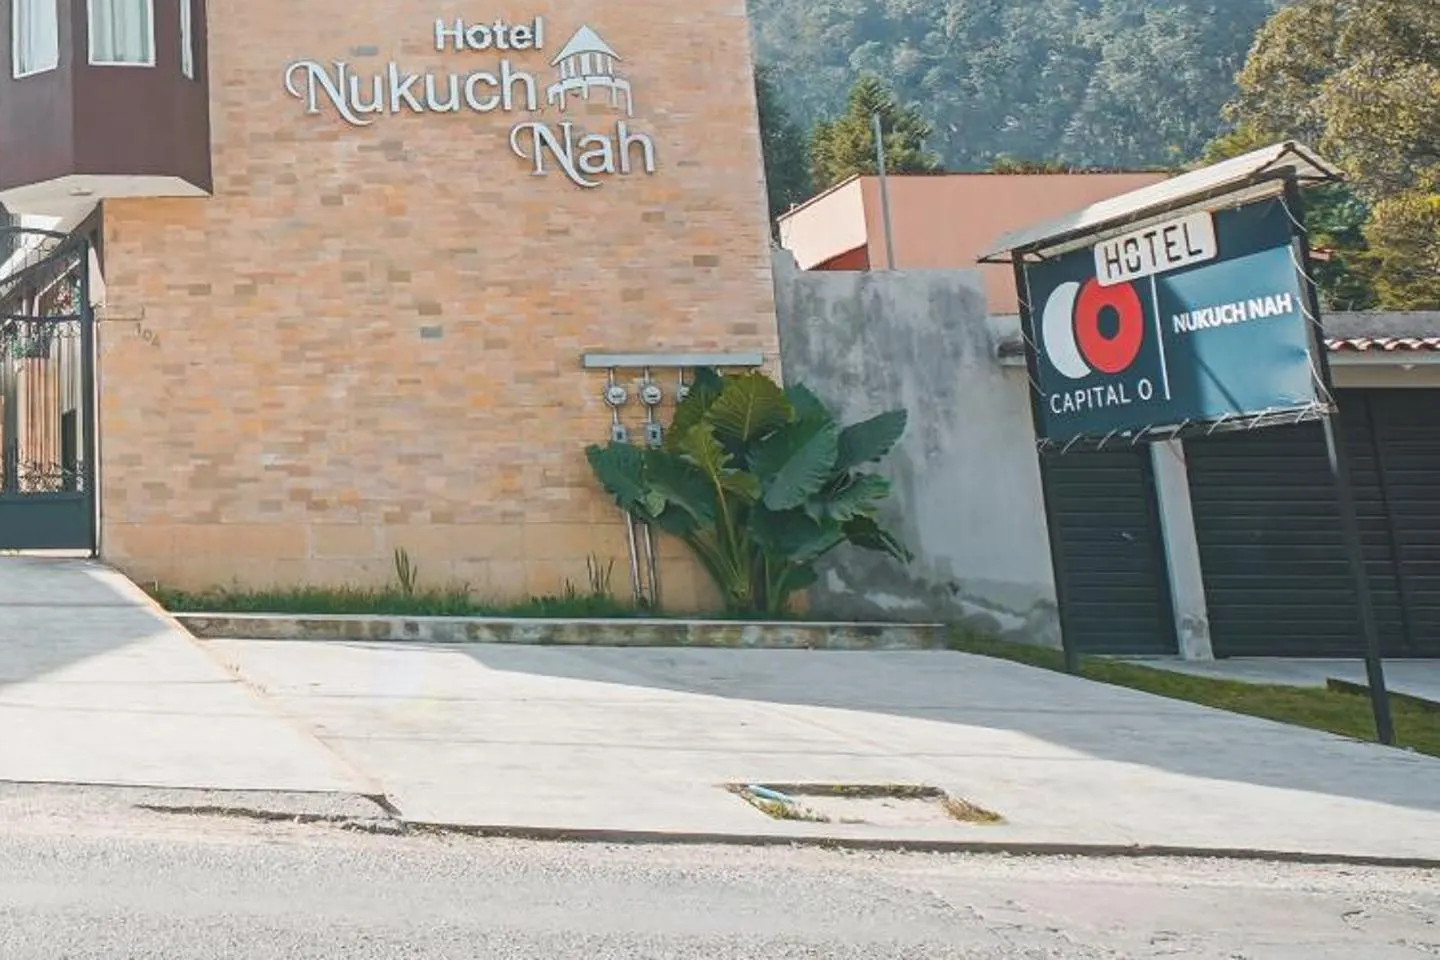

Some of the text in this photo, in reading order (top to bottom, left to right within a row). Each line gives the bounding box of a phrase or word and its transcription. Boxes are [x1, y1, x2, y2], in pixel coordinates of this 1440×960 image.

[434, 16, 543, 50] Hotel
[285, 59, 537, 125] Nukuch
[510, 119, 656, 187] Nah
[1103, 222, 1203, 279] HOTEL
[1172, 292, 1293, 333] NUKUCH NAH
[1050, 378, 1153, 414] CAPITAL O
